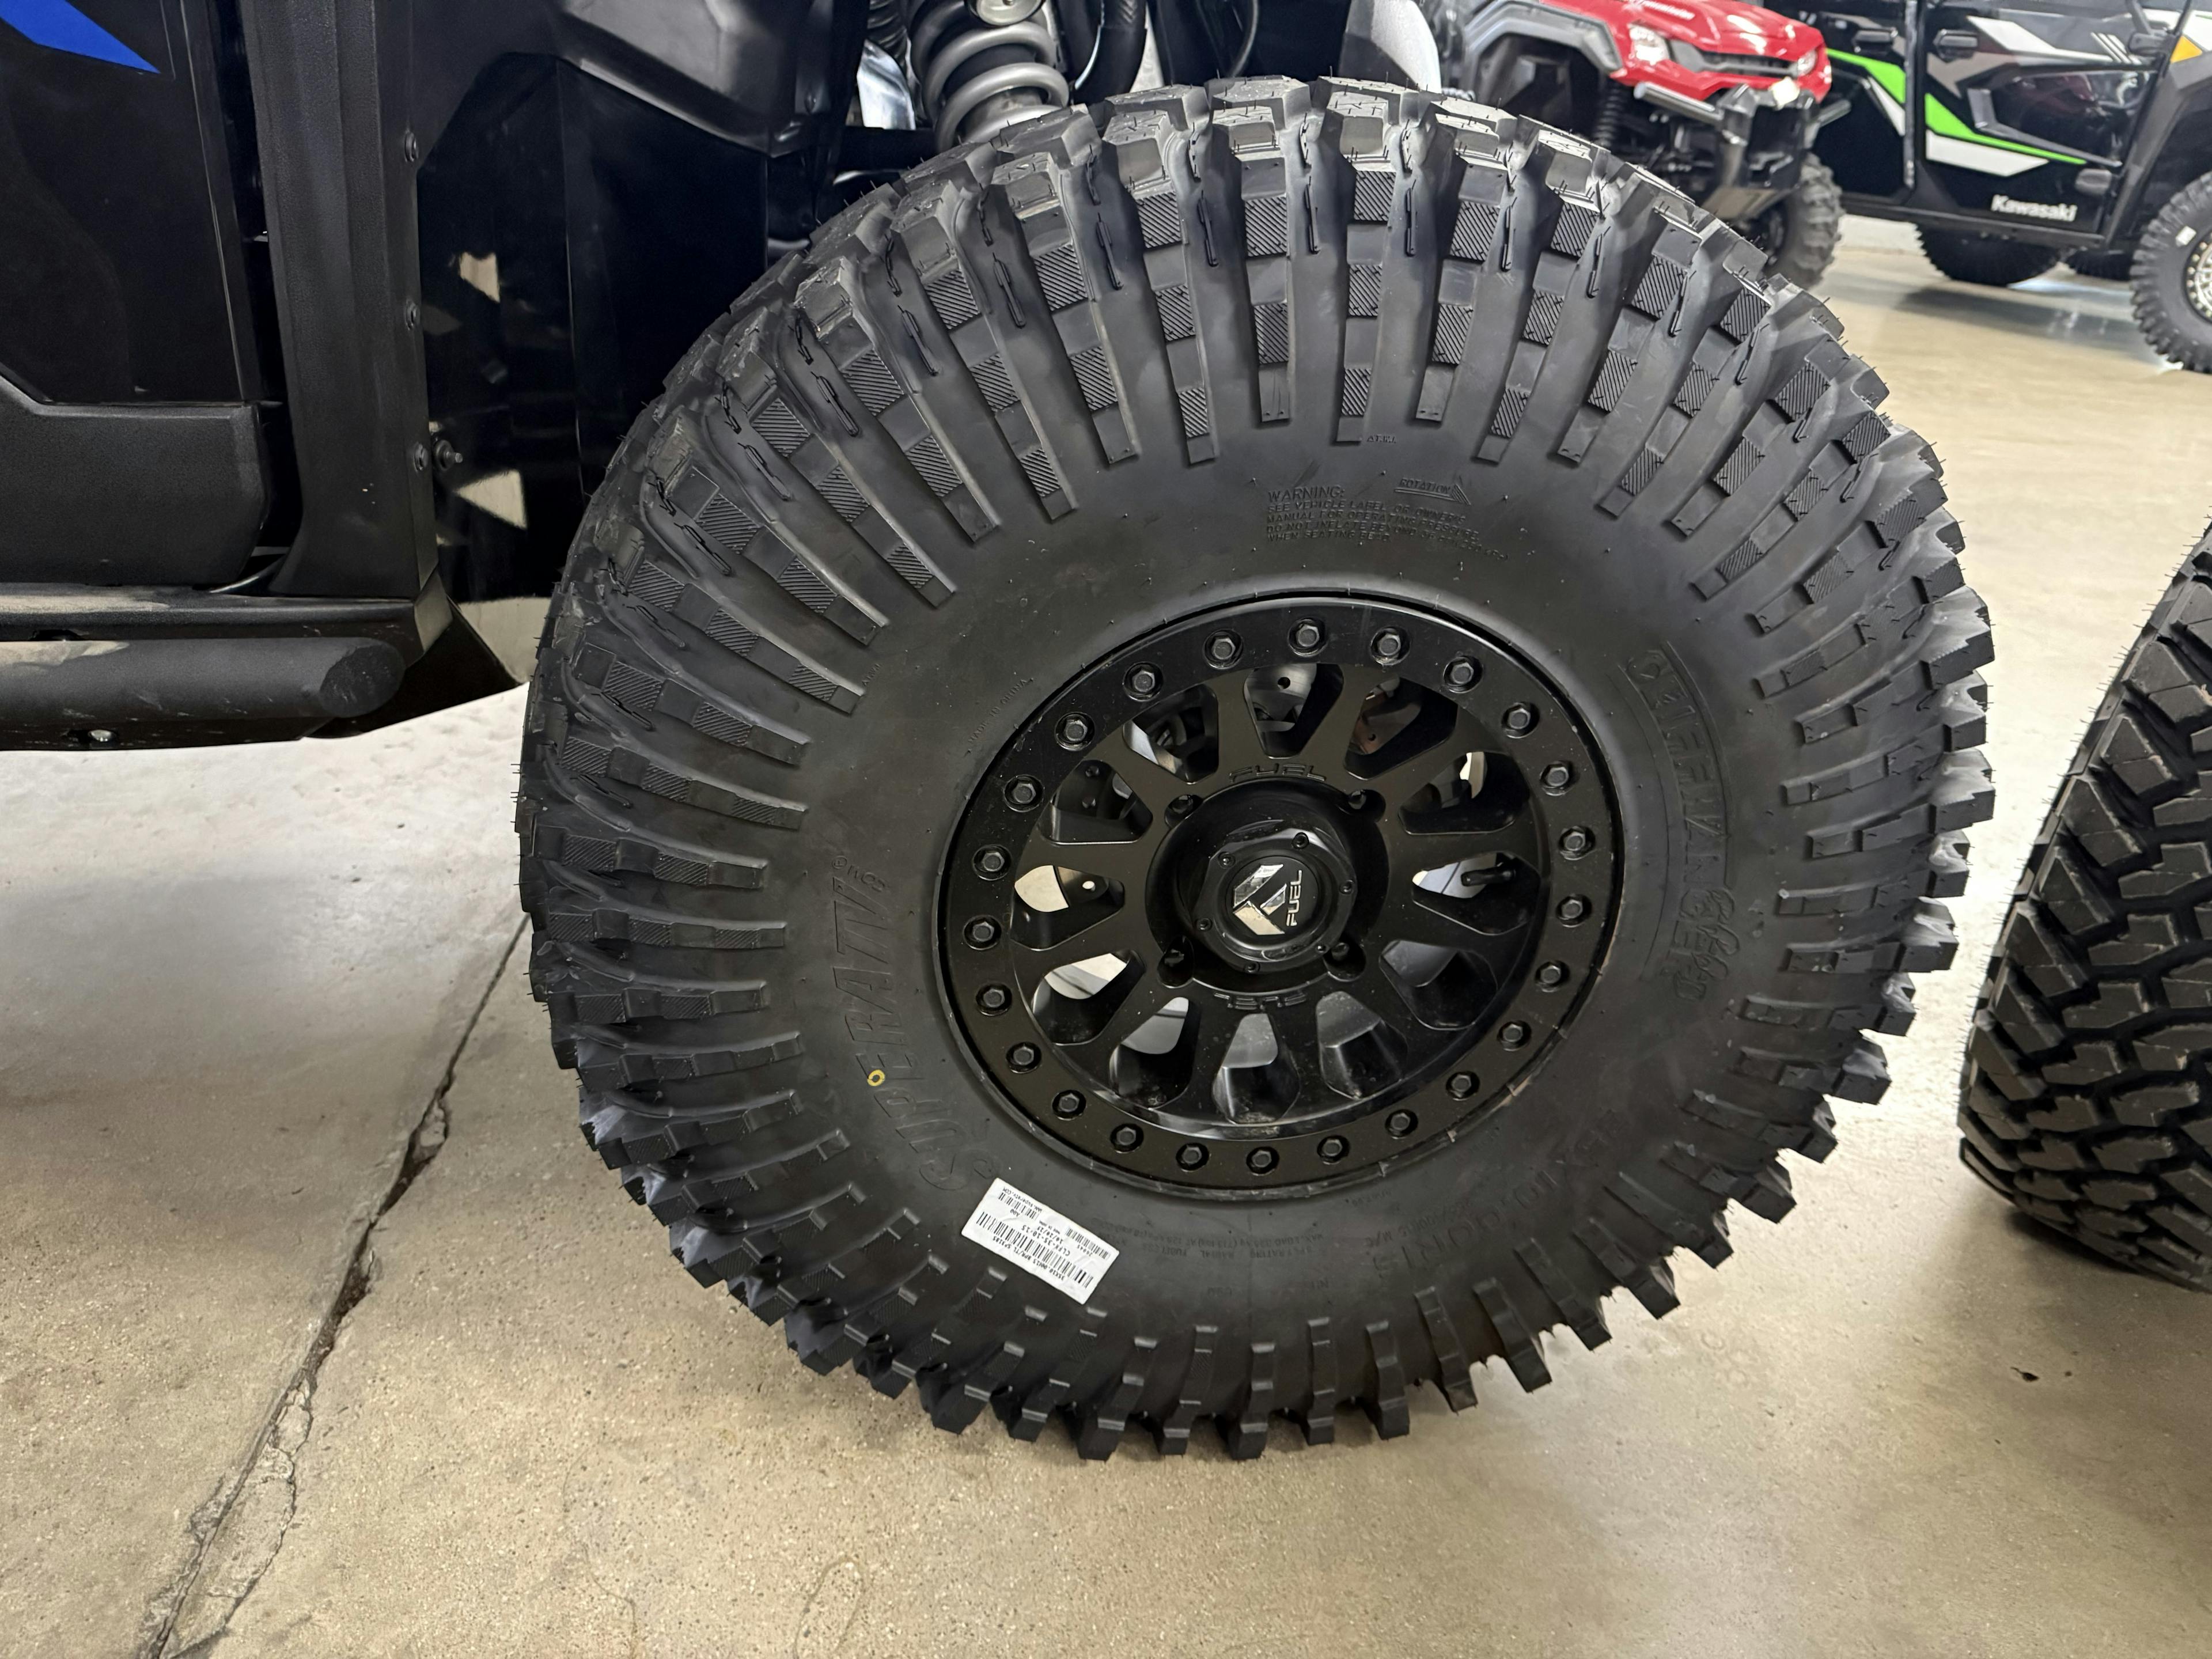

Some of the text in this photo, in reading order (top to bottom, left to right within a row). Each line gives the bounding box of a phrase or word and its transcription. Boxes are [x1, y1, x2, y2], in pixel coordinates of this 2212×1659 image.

[1991, 194, 2078, 222] Kawasaki
[1268, 484, 1345, 503] WARNING:
[1400, 478, 1452, 495] ROTATION
[1268, 502, 1290, 513] SEE
[1296, 499, 1346, 510] VEHICLE
[1267, 512, 1315, 524] MANUAL
[1320, 509, 1344, 519] FOR
[1287, 520, 1312, 530] NOT
[1268, 532, 1298, 541] WHEN
[1304, 528, 1355, 540] SEATING
[1228, 763, 1327, 783] FUEL
[1286, 869, 1303, 927] FUEL
[832, 876, 1000, 1191] SUPERATV
